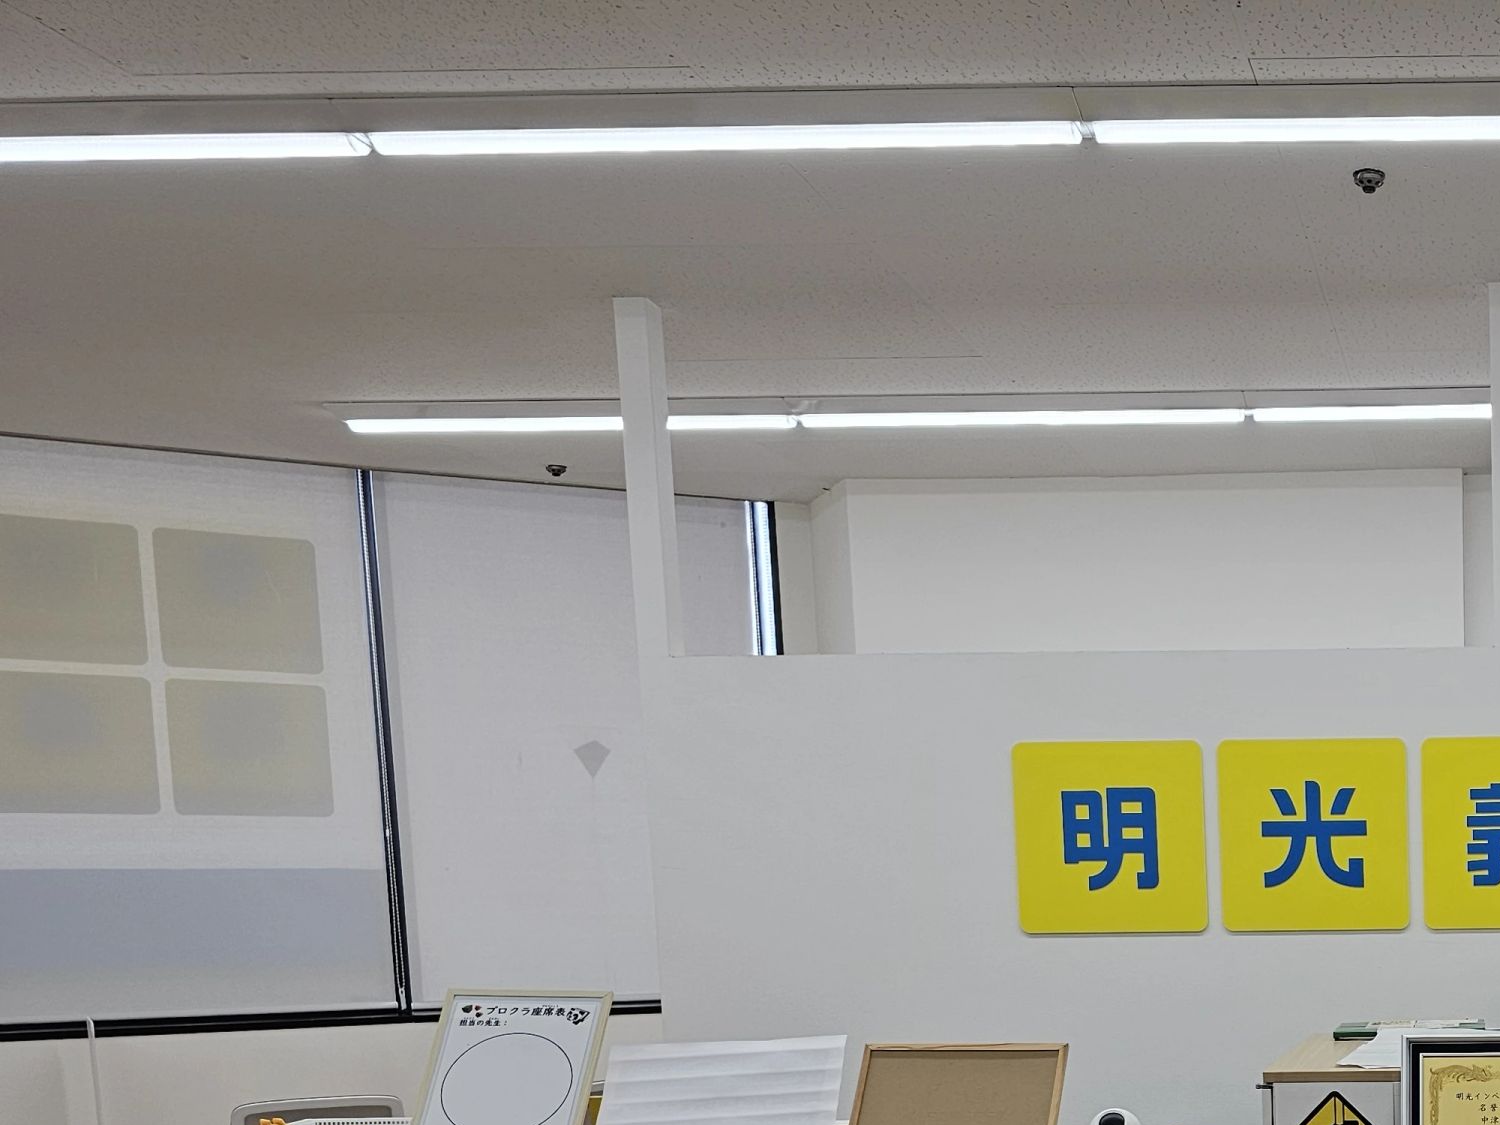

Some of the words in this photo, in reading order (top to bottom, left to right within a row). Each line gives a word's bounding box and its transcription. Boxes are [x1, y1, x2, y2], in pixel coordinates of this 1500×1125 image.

[486, 1006, 567, 1017] プロクラ座席表
